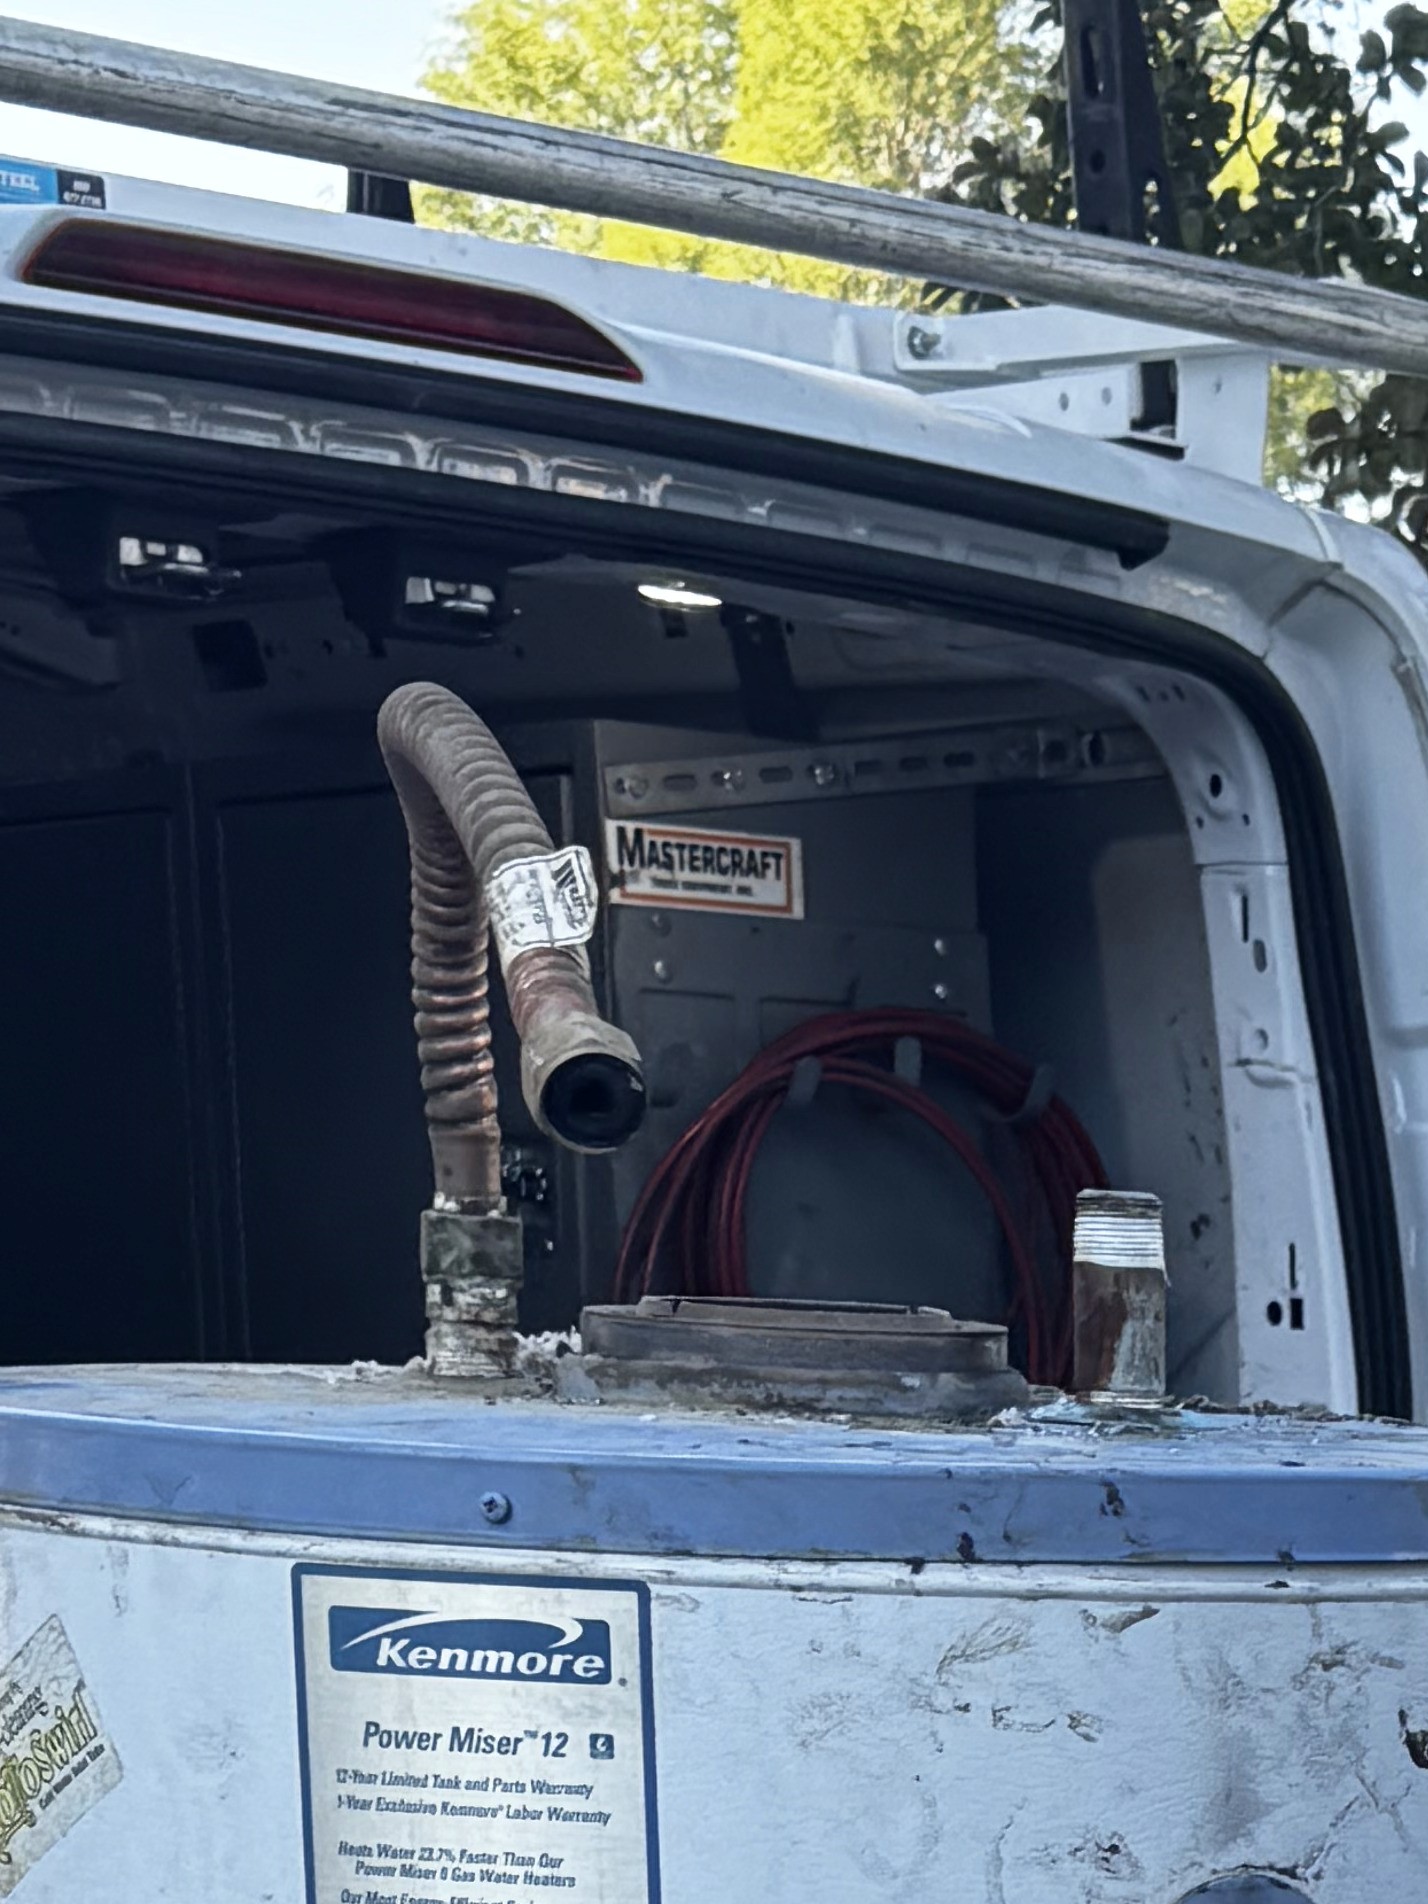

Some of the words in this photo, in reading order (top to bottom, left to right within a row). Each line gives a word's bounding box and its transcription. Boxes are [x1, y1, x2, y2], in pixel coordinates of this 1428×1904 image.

[376, 1637, 606, 1677] Kenmore
[362, 1721, 443, 1751] Power
[541, 1732, 569, 1757] 12
[464, 1776, 490, 1791] and
[492, 1777, 526, 1793] Parts
[530, 1779, 594, 1800] Warranty
[506, 1804, 543, 1820] Labor
[547, 1806, 612, 1827] Warranty
[377, 1844, 416, 1860] Water
[459, 1849, 498, 1864] Faster
[503, 1852, 536, 1867] Than
[355, 1861, 397, 1877] Power
[479, 1869, 520, 1884] Water
[523, 1871, 576, 1887] Heaters
